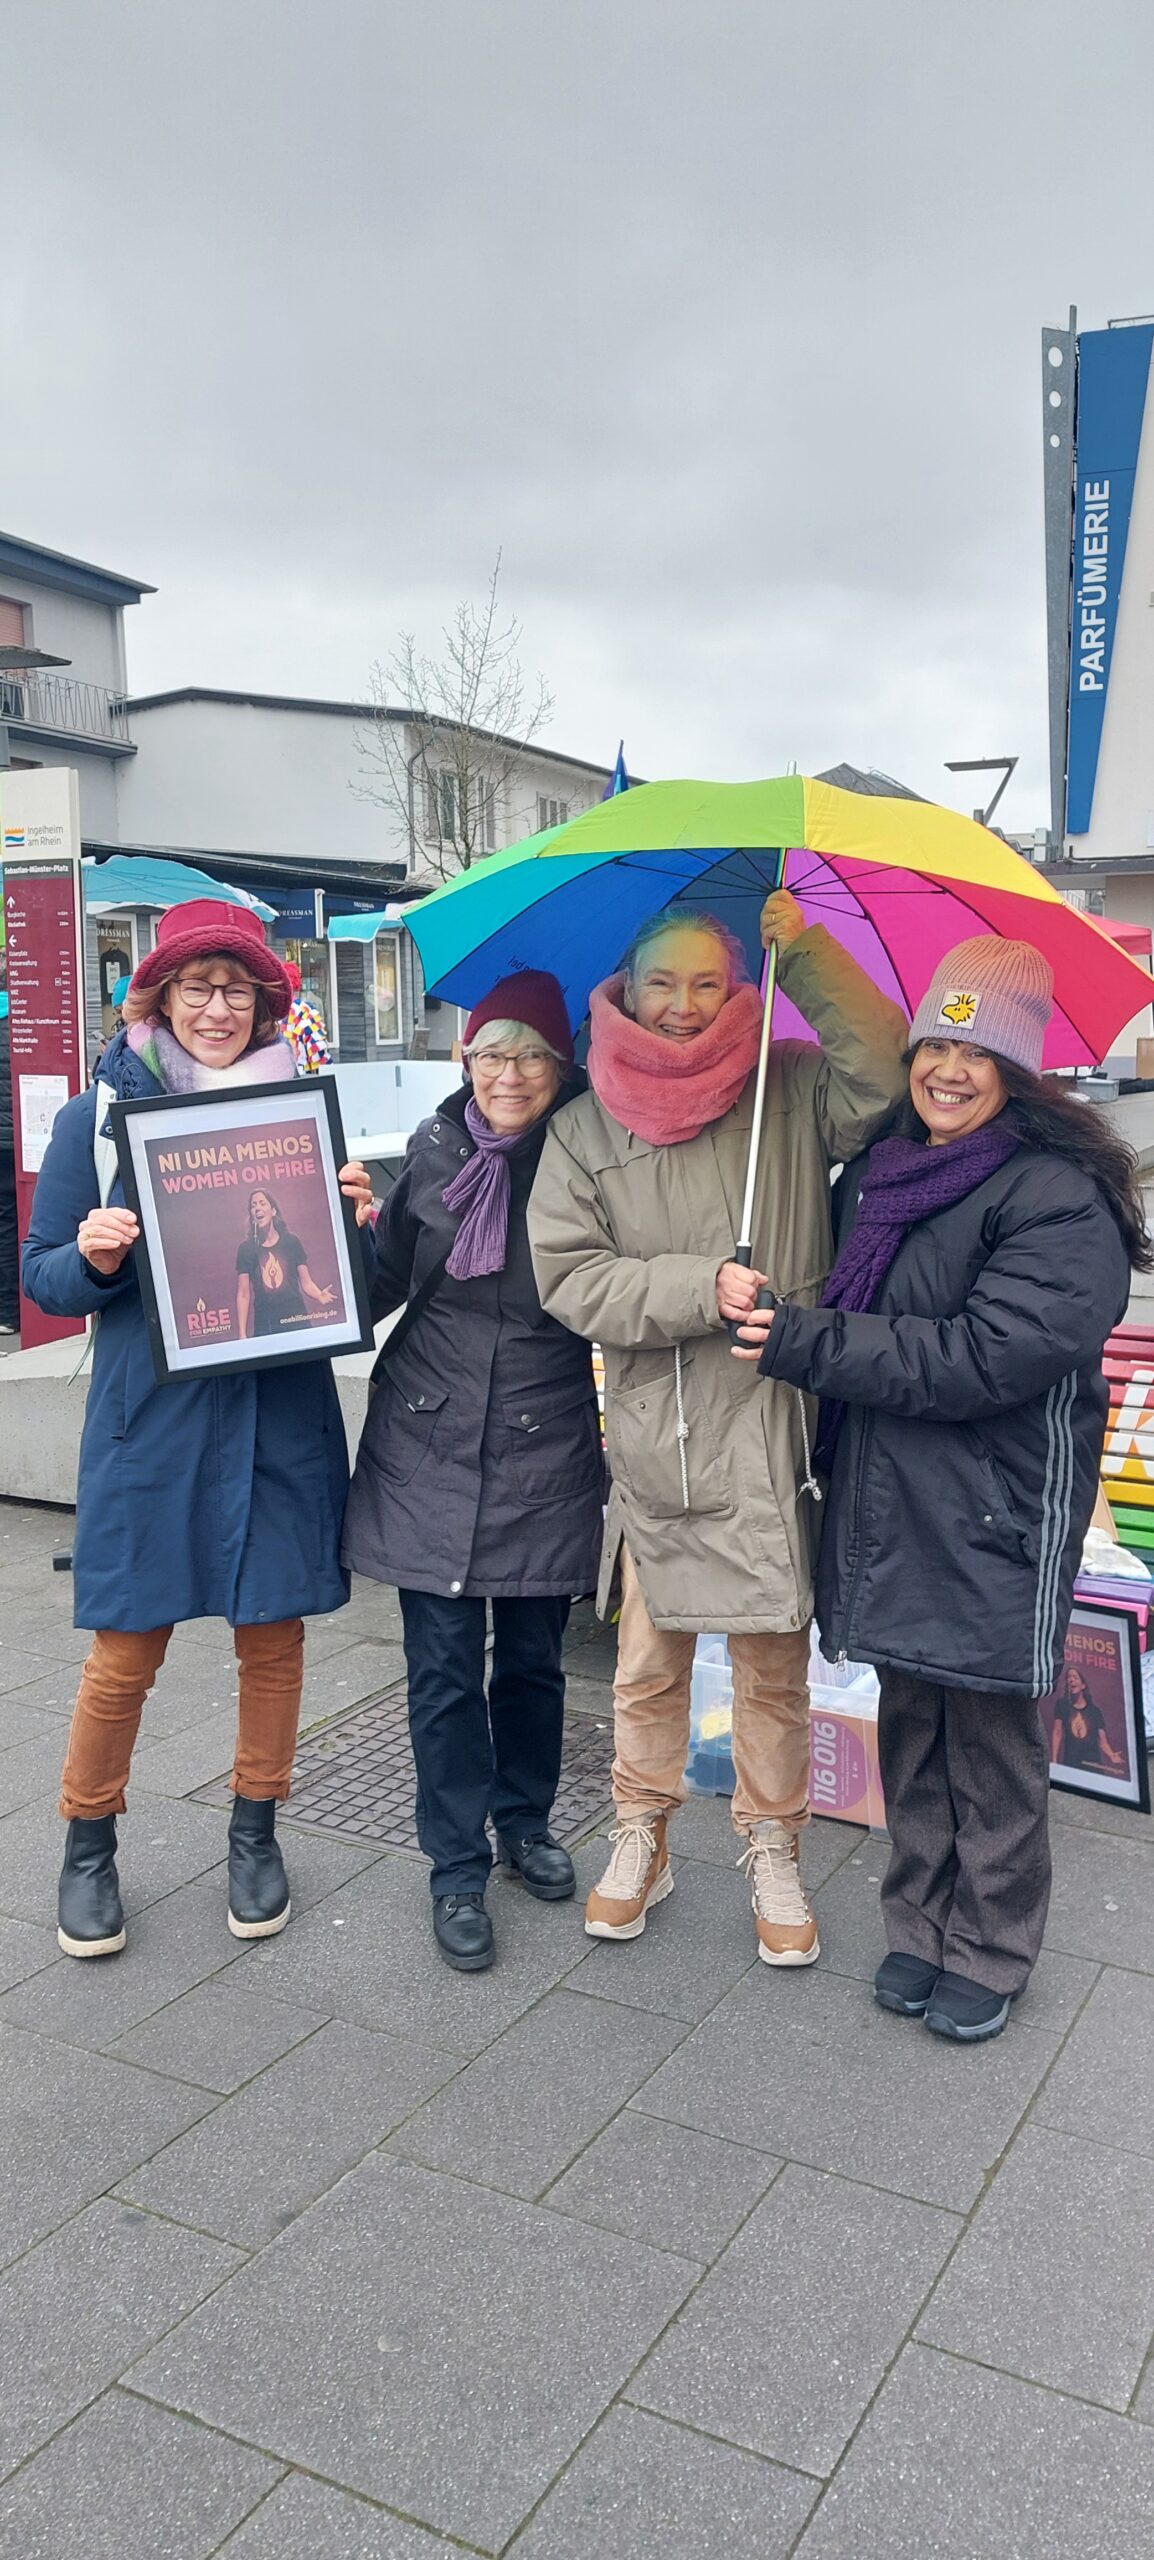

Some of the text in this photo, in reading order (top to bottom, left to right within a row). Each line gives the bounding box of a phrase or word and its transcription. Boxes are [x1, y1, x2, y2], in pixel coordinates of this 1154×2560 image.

[1077, 480, 1110, 691] PARFÜMERIE
[28, 825, 63, 836] Ingelheim
[28, 836, 61, 846] am Rhein
[4, 865, 69, 875] Sebastian-Münster-Platz
[158, 1134, 313, 1173] NI UNA MENOS
[162, 1158, 316, 1194] WOMEN ON FIRE
[187, 1308, 231, 1331] RISE
[279, 1309, 338, 1324] onebillionrising.de
[203, 1325, 231, 1335] EMPATHY
[1086, 1654, 1117, 1671] FIRE
[813, 1721, 837, 1805] 116 016
